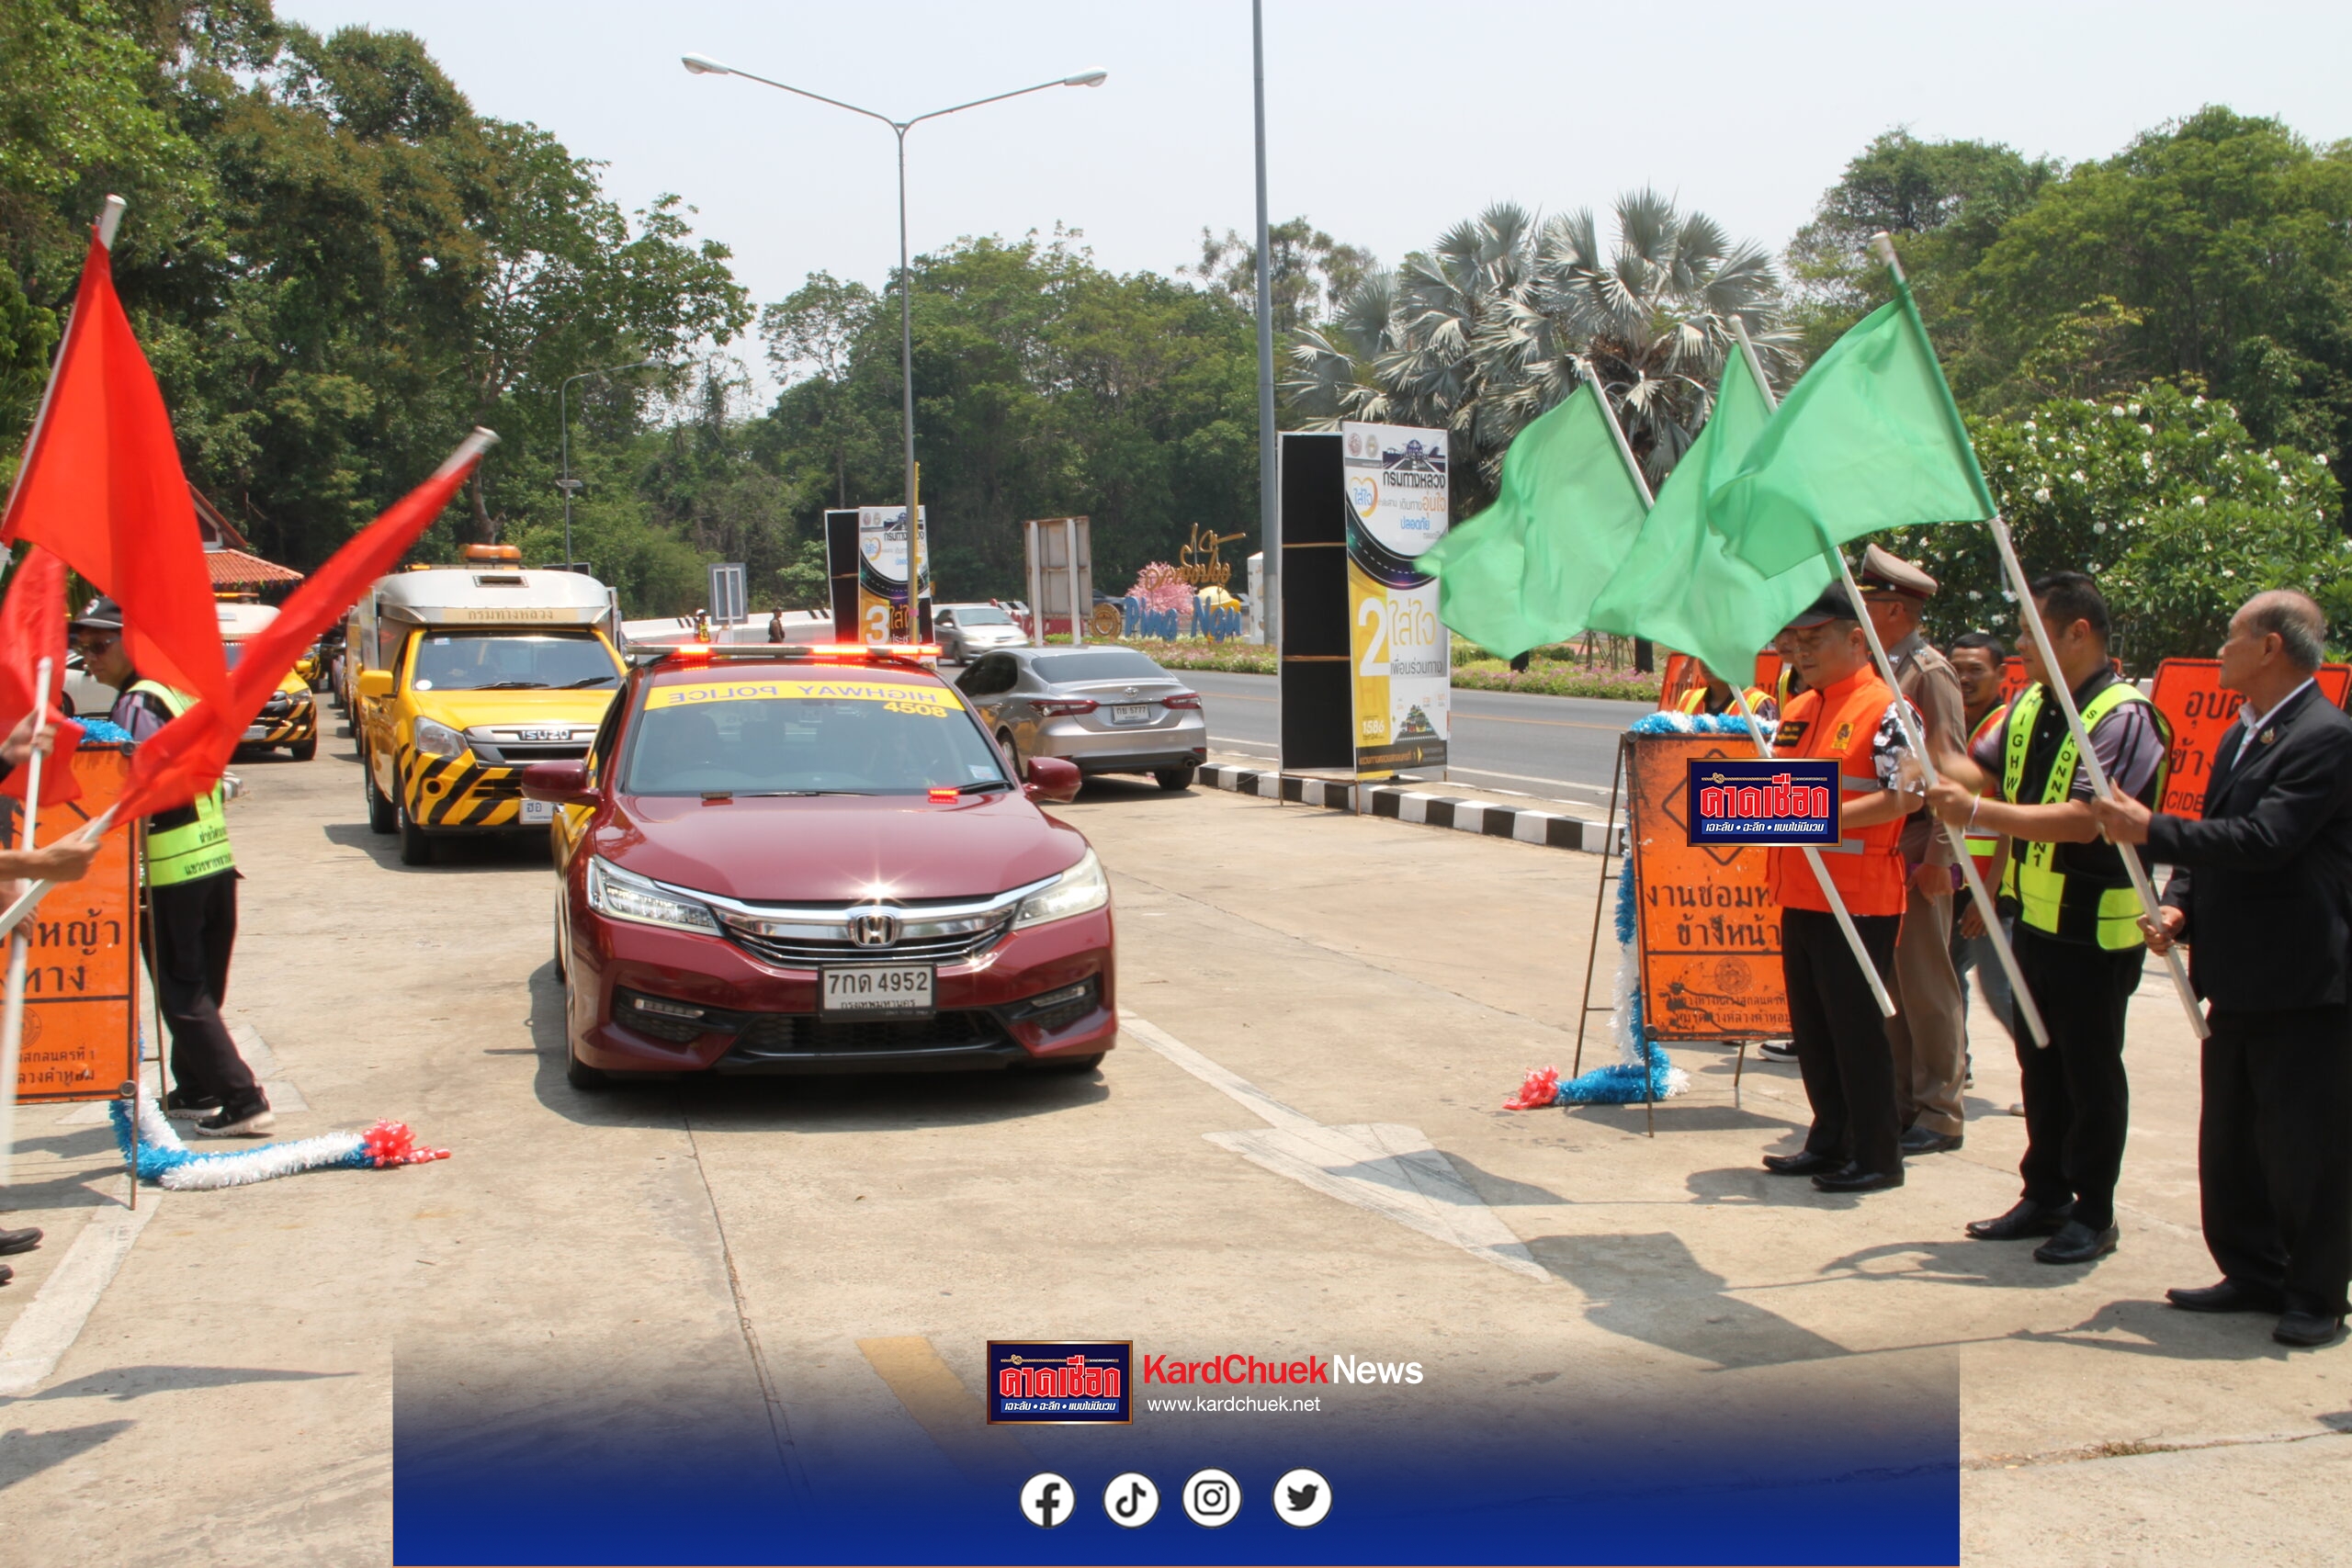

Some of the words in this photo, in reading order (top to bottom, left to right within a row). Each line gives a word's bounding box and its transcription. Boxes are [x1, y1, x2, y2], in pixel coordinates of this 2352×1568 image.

[1383, 471, 1446, 489] กรมทางหลวง
[468, 610, 553, 621] กรมทางหลวง
[865, 604, 890, 645] 3
[1358, 597, 1390, 676] 2
[883, 701, 949, 718] 4508
[1363, 719, 1385, 735] 1586
[829, 974, 872, 994] 7กด
[878, 972, 928, 991] 4952
